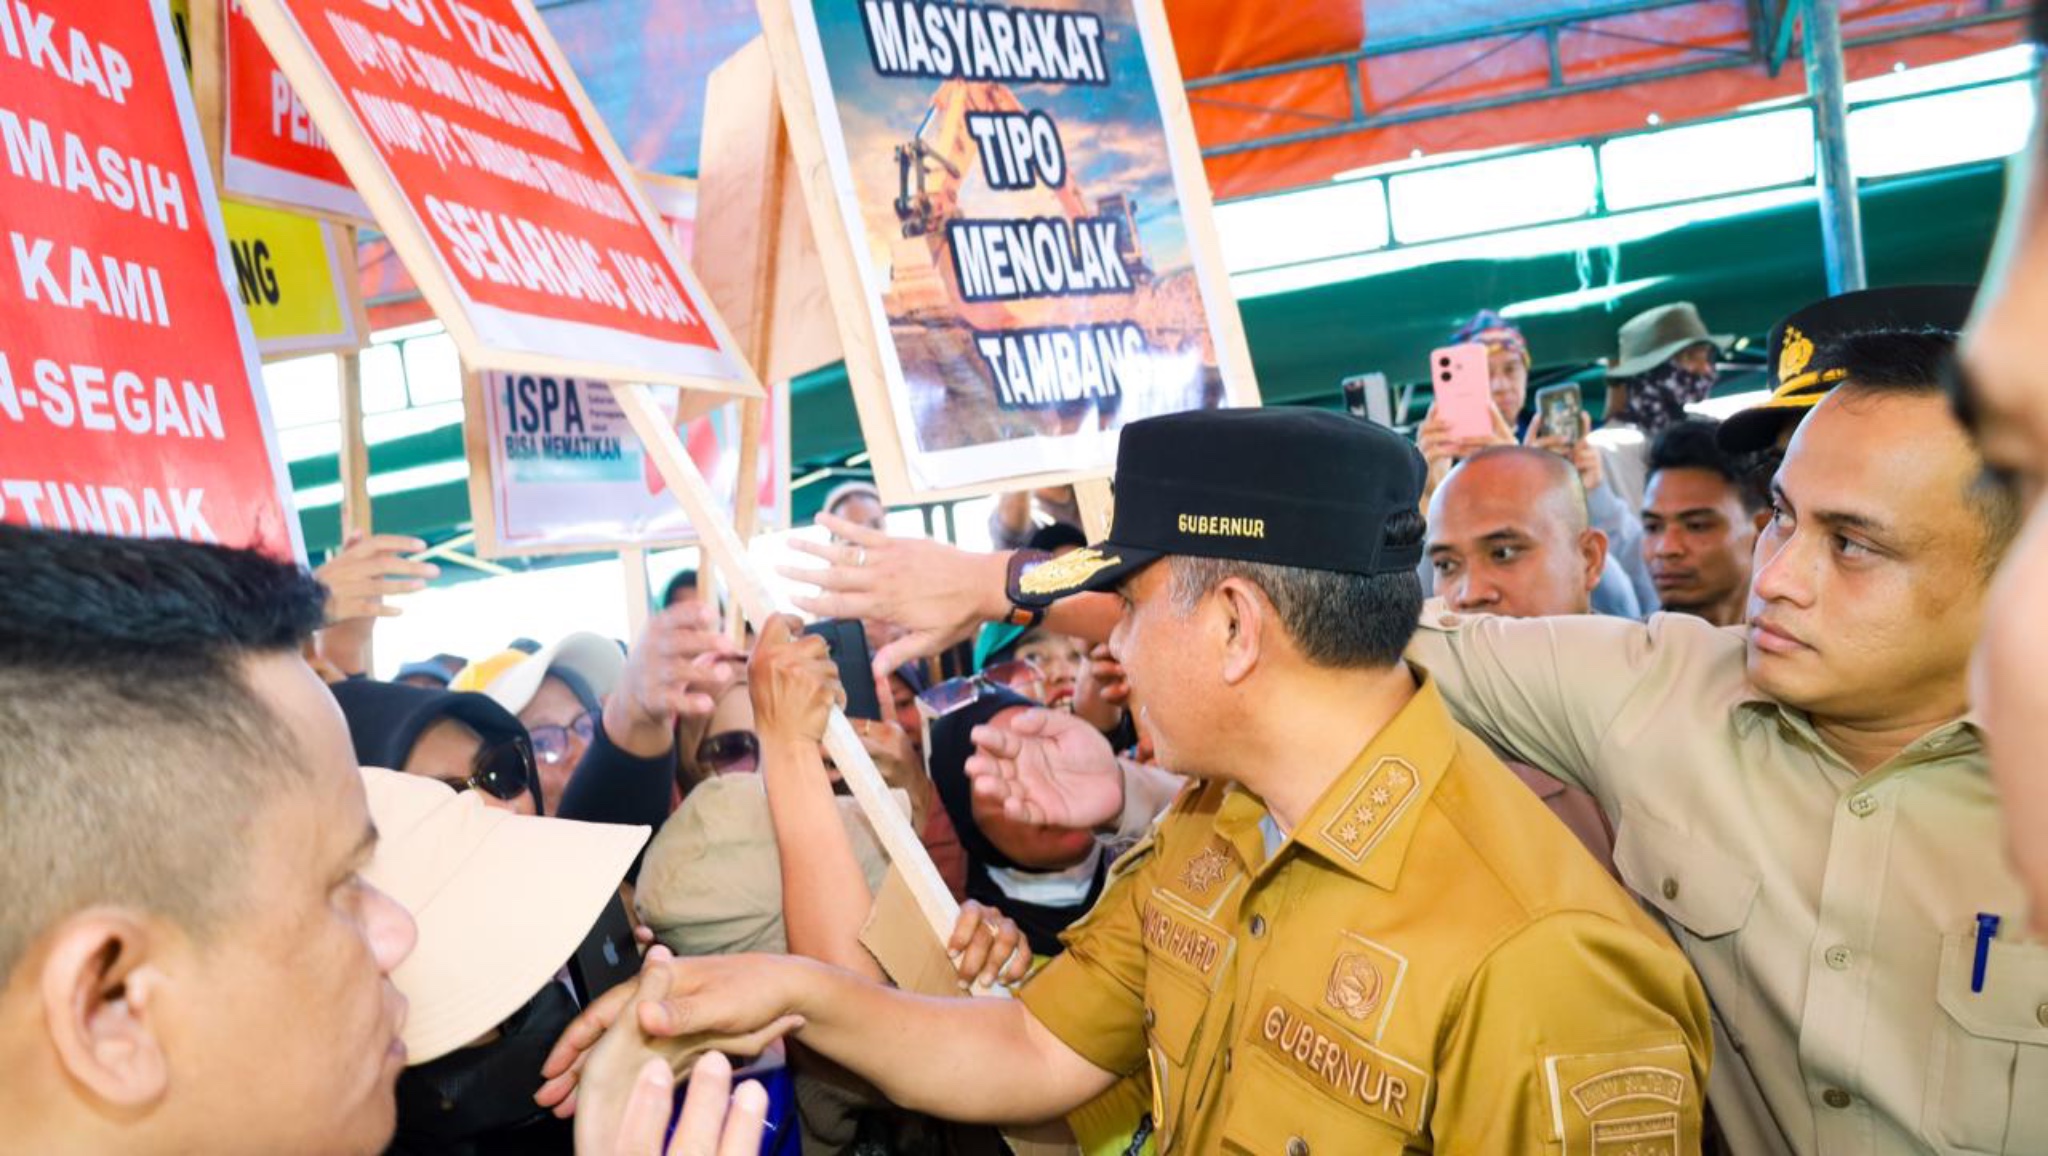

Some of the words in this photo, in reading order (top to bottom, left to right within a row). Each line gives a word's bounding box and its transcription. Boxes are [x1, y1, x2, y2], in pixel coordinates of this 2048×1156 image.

[864, 3, 1105, 81] MASYARAKAT
[0, 107, 189, 230] MASIH
[970, 117, 1062, 186] TIPO
[10, 231, 171, 328] KAMI
[424, 194, 628, 311] SEKARANG
[607, 247, 699, 327] JUGA
[951, 222, 1130, 298] MENOLAK
[505, 374, 585, 434] ISPA
[505, 435, 538, 461] BISA
[542, 436, 622, 461] MEMATIKAN
[0, 478, 218, 545] TINDAK
[1178, 513, 1265, 539] GUBERNUR
[1263, 1005, 1408, 1118] GUBERNUR
